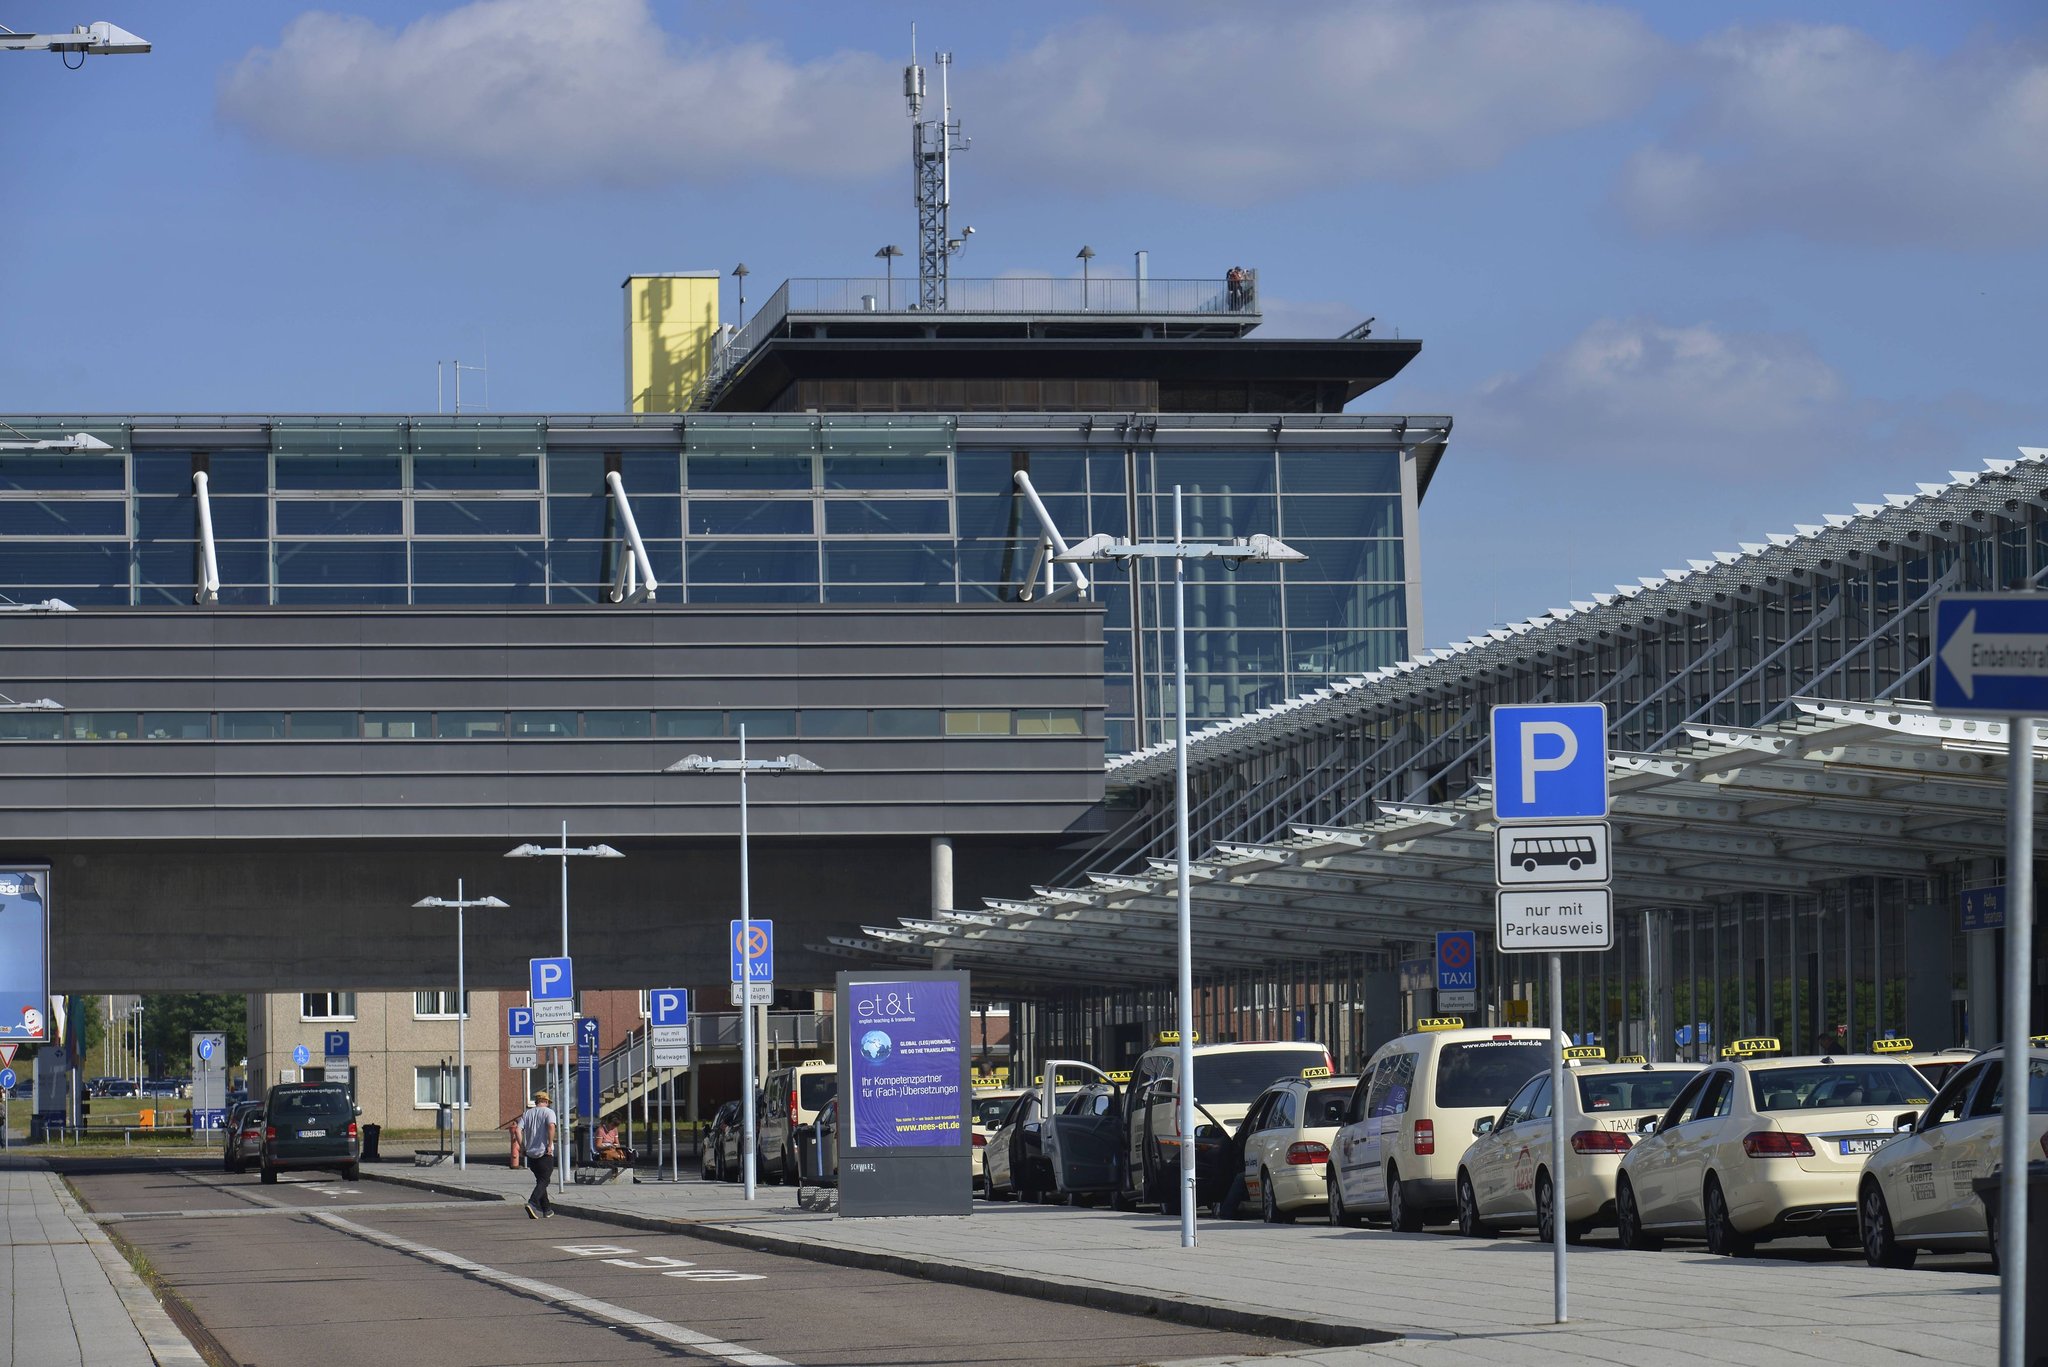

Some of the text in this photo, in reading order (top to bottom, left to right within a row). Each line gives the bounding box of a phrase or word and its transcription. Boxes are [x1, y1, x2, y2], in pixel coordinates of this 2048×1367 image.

[1971, 643, 2048, 668] Einbahnstra
[1520, 722, 1578, 803] P
[1526, 903, 1583, 917] nur mit
[1506, 922, 1603, 936] Parkausweis
[540, 964, 562, 994] P
[1441, 972, 1472, 985] TAXI
[735, 993, 770, 1001] Auteigen
[659, 994, 678, 1021] P
[858, 992, 915, 1016] et&t
[515, 1012, 530, 1032] P
[1463, 1040, 1542, 1049] www.autohaus-burkard.de
[1743, 1041, 1771, 1049] TAXI
[1881, 1040, 1907, 1048] TAXI
[1571, 1049, 1597, 1057] TAXI
[861, 1075, 942, 1085] Ihr Kompetenzpartner
[862, 1085, 959, 1098] für (Fach-)Übersetzungen
[896, 1121, 960, 1132] www.nees-ett.de
[552, 1244, 768, 1282] BUS
